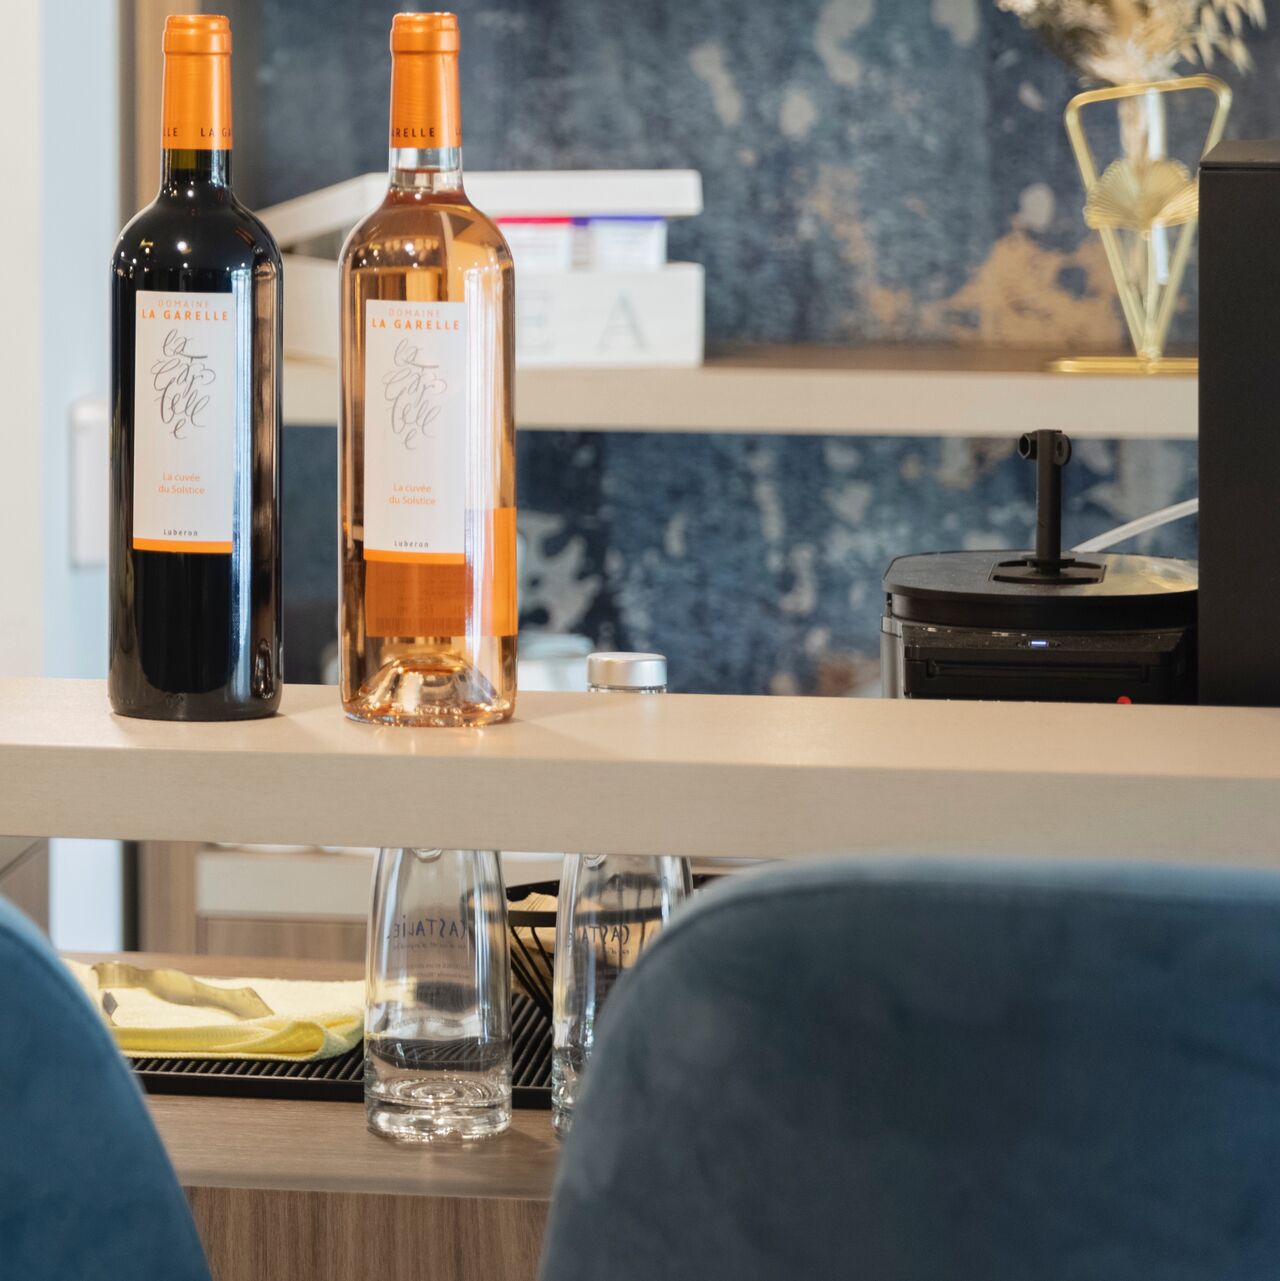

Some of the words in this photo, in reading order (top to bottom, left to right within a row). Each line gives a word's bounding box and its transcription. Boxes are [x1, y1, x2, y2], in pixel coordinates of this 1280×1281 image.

[158, 299, 209, 309] DOMAINE
[141, 308, 156, 320] LA
[163, 310, 229, 321] GARELLE
[388, 308, 442, 318] DOMAINE
[371, 318, 386, 329] LA
[393, 319, 460, 331] GARELLE
[163, 472, 173, 481] La
[158, 484, 169, 493] du
[171, 485, 206, 495] Solstice
[393, 483, 403, 492] La
[389, 495, 400, 504] du
[402, 496, 436, 505] Solstice
[163, 529, 199, 537] Luberon
[394, 540, 429, 548] Luberon
